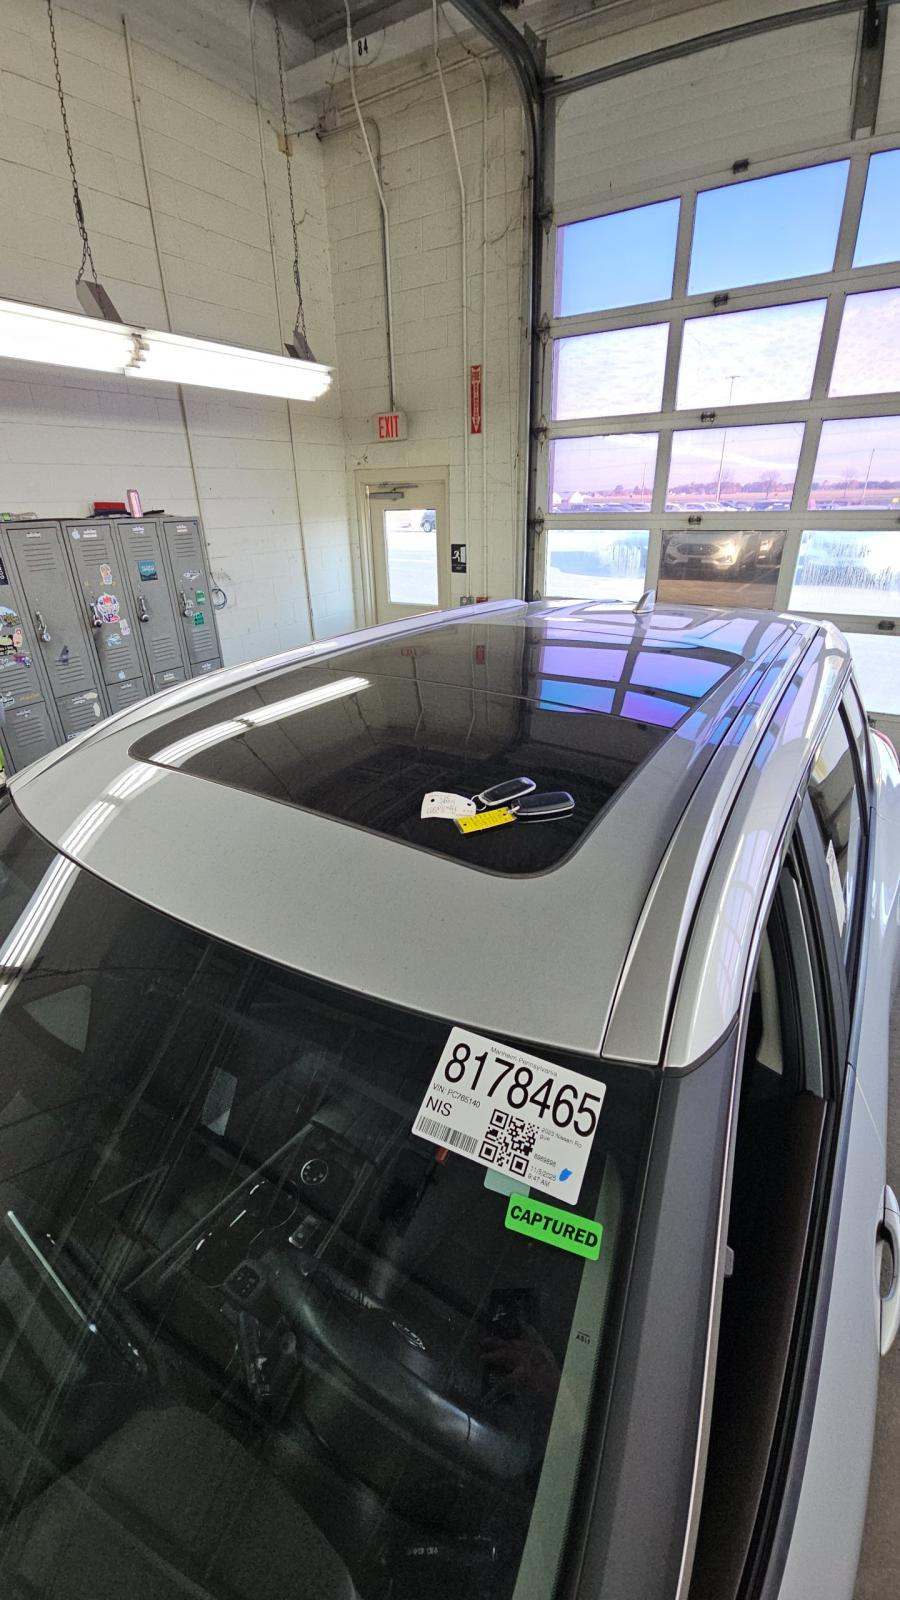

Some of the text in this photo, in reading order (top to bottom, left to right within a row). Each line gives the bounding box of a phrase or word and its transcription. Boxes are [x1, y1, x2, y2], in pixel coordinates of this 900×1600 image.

[357, 36, 369, 56] 84
[378, 415, 399, 438] EXIT
[518, 1057, 558, 1077] Pennsylvania
[444, 1042, 600, 1137] 8178465
[426, 1095, 452, 1117] NIS
[510, 1204, 598, 1248] CAPTURED
